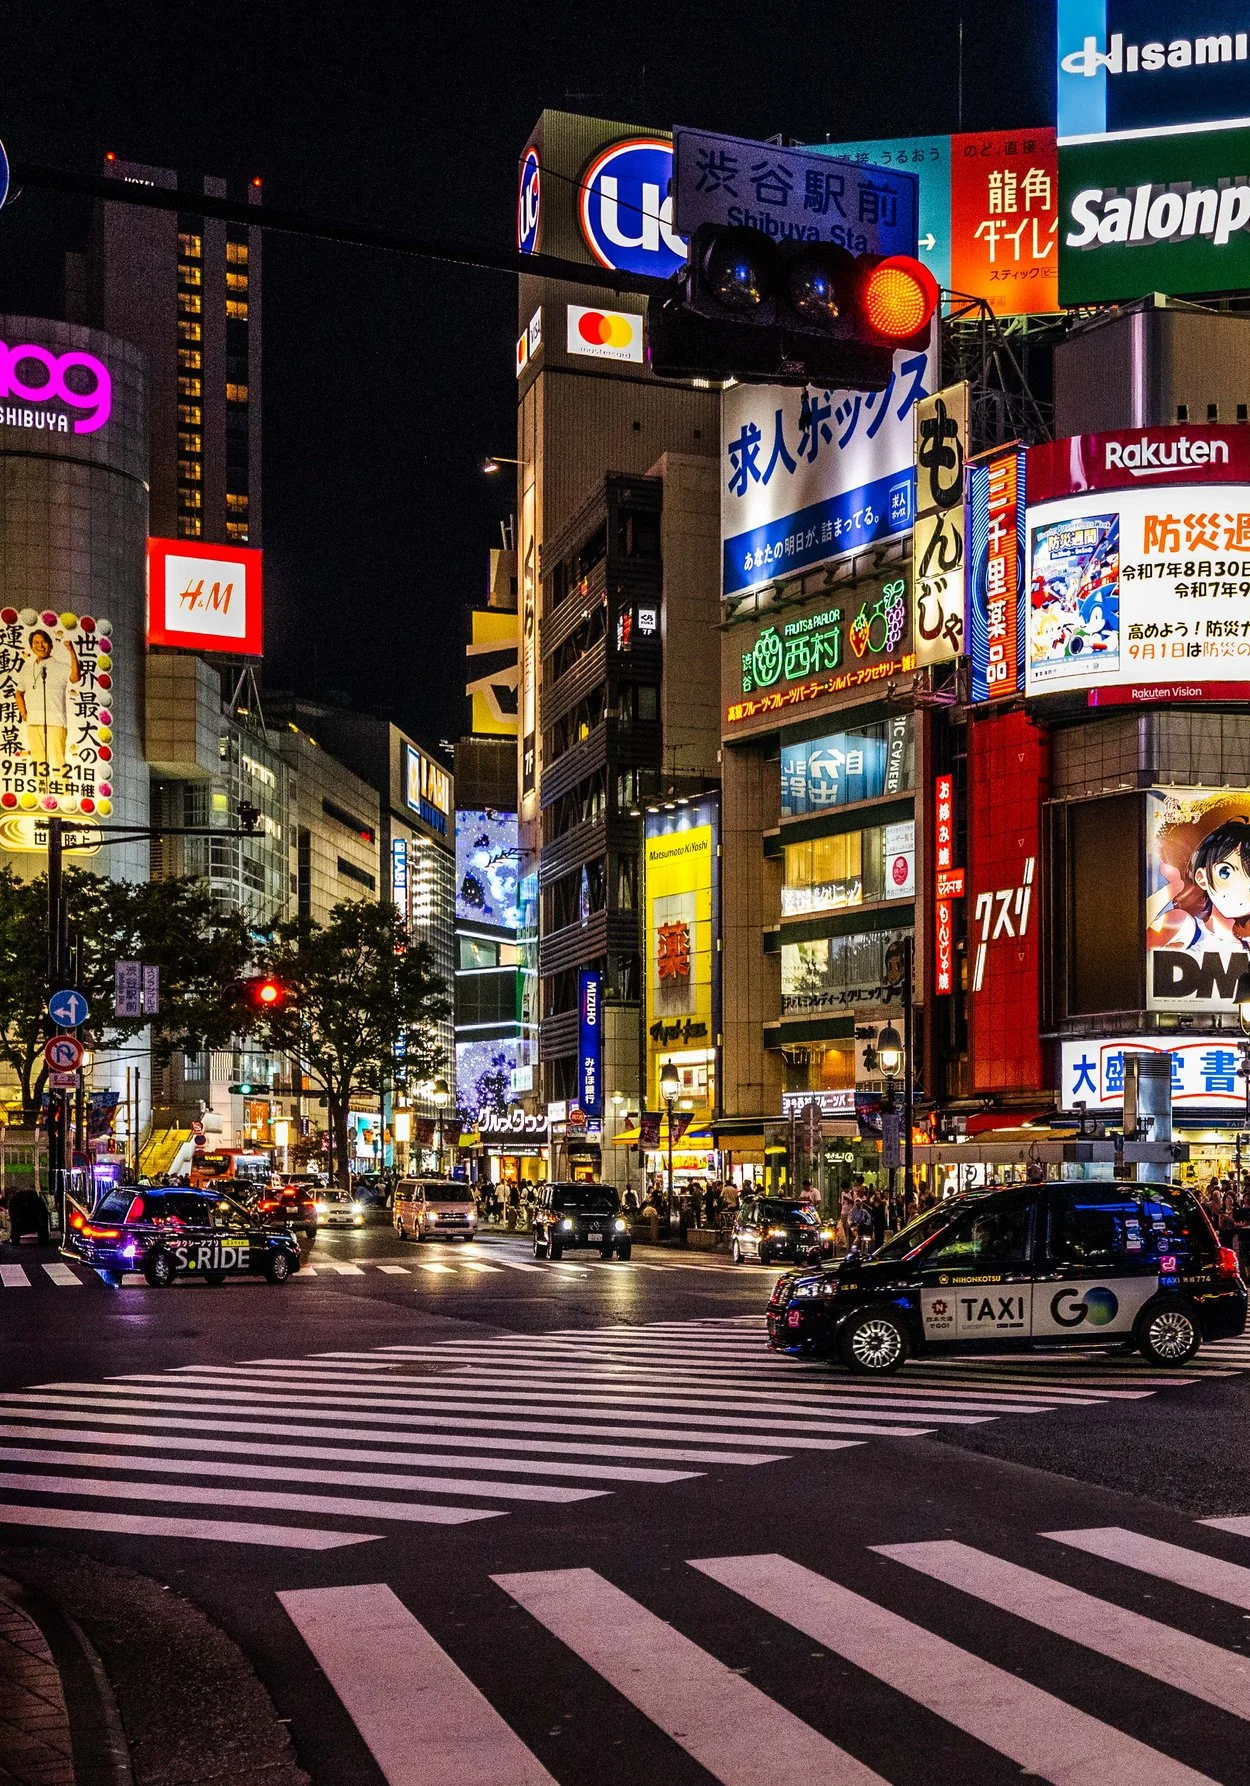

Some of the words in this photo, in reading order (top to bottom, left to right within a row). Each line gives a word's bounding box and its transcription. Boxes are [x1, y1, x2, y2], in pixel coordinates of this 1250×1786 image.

[696, 150, 898, 227] 渋谷駅前
[973, 217, 1058, 263] ダイレ
[990, 268, 1039, 282] スティック
[728, 353, 930, 497] 求人ボックス
[1105, 436, 1229, 471] Rakuten
[891, 493, 906, 508] 求人
[918, 398, 963, 652] もんじゃ
[1049, 528, 1098, 552] 防災週間
[986, 468, 1007, 683] 三千里薬品
[179, 578, 234, 615] H&M
[785, 609, 840, 636] FRUITS&PARLOR
[785, 627, 840, 680] 西村
[0, 624, 25, 758] 運動会開幕
[742, 654, 752, 692] 渋谷
[74, 632, 100, 764] 世界最大の
[1131, 687, 1170, 699] Rakuten
[1172, 686, 1202, 698] Vision
[649, 846, 684, 861] Matsumoto
[973, 857, 1035, 991] クスリ
[658, 922, 690, 979] 薬
[587, 981, 596, 1026] MIZUHO
[585, 1057, 595, 1104] みずほ銀行
[478, 1107, 549, 1134] グルメタウン
[175, 1247, 249, 1270] S.RIDE
[177, 1240, 219, 1248] タクシーアプリ
[952, 1275, 1001, 1283] NIHONKOTSU
[961, 1297, 1024, 1321] TAXI
